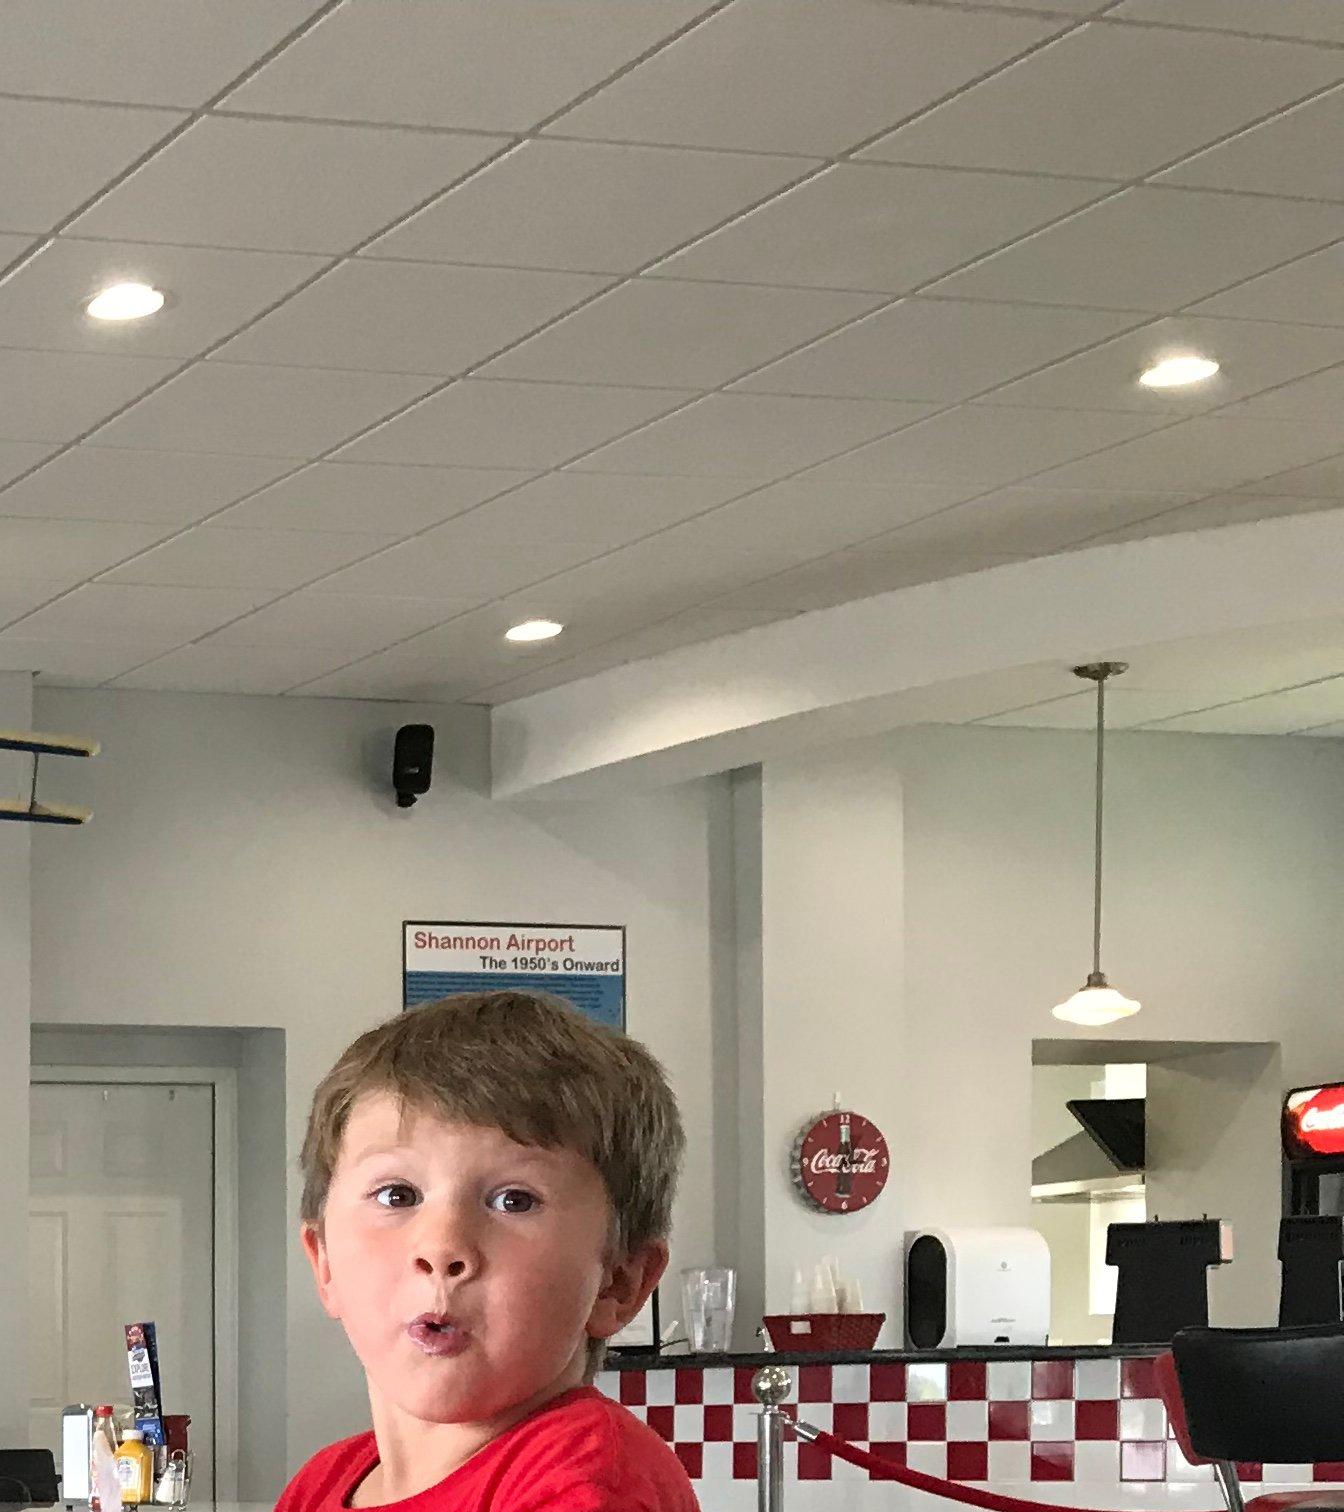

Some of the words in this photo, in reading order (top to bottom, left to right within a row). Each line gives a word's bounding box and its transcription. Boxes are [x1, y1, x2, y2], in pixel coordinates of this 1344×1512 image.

[414, 931, 501, 950] Shannon
[506, 934, 576, 955] Airport
[480, 956, 506, 970] The
[512, 957, 559, 971] 1950's
[563, 958, 620, 972] Onward
